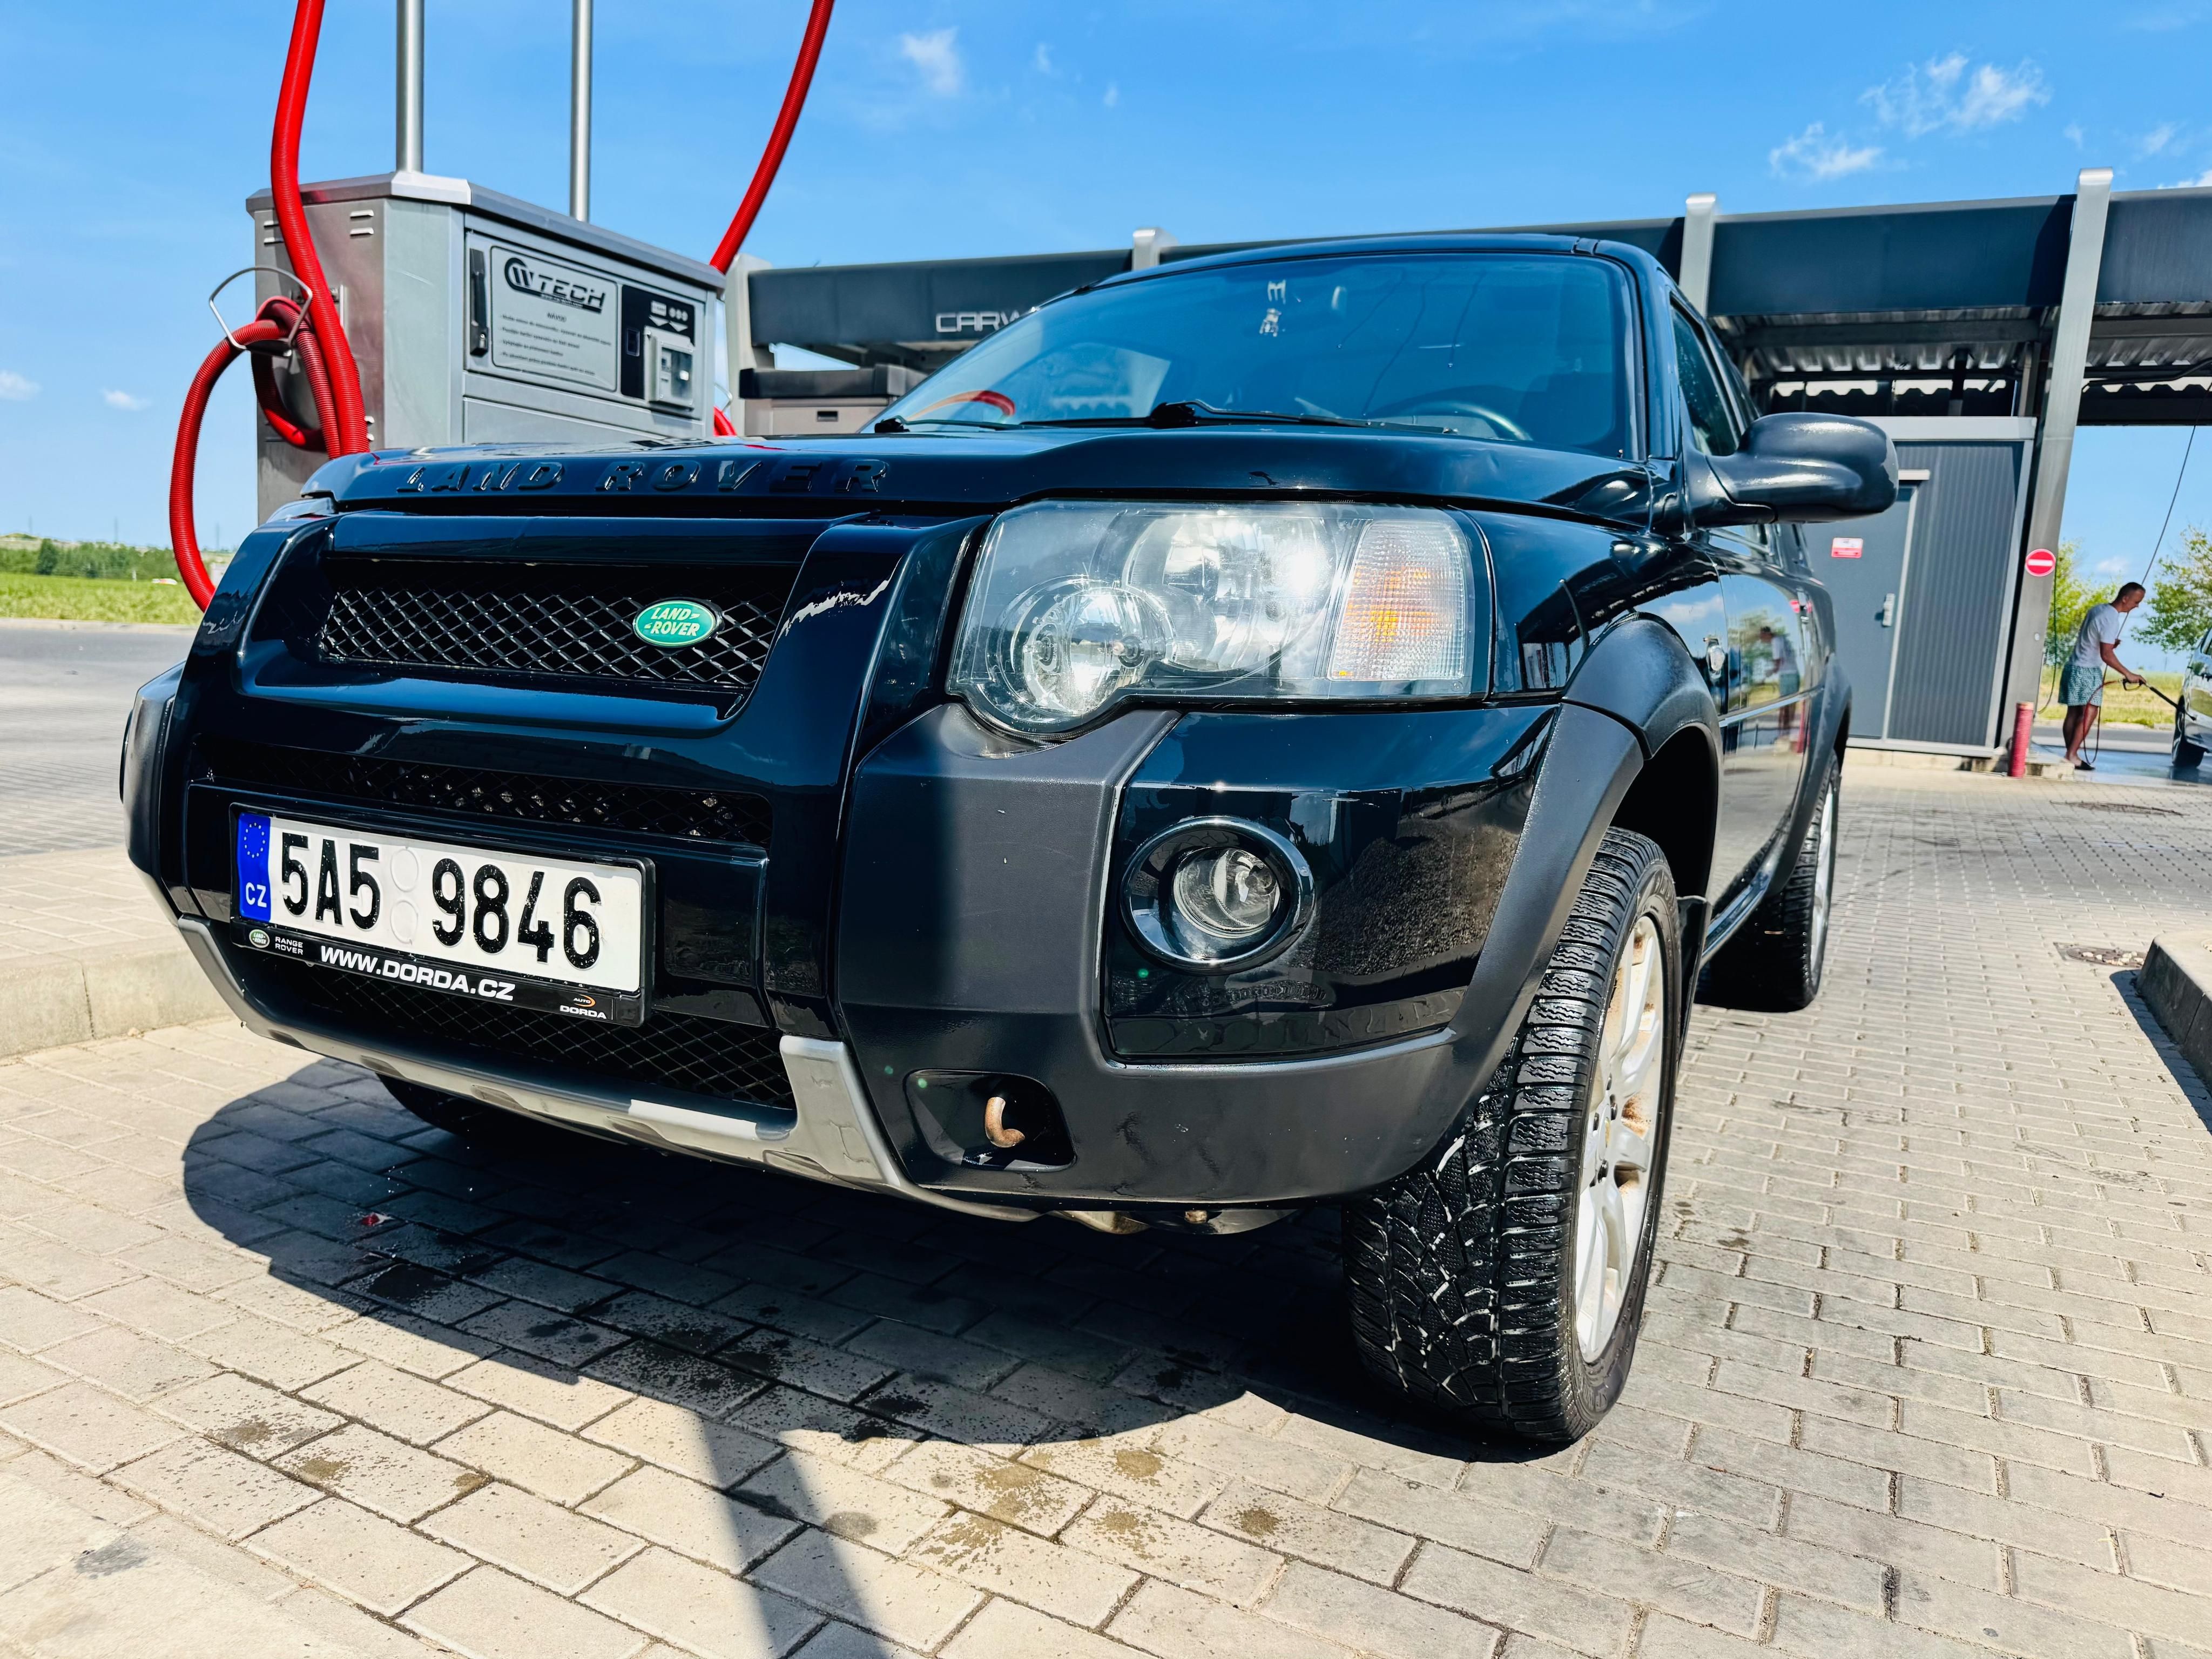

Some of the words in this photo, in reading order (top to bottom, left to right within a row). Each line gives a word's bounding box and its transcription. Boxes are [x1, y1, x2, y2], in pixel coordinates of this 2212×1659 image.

[538, 274, 605, 308] TECH
[396, 461, 565, 493] LAND
[594, 460, 889, 493] ROVER
[650, 621, 700, 636] ROVER
[245, 882, 267, 908] CZ
[282, 832, 381, 931] 5A5
[433, 858, 601, 969] 9846
[275, 936, 303, 948] RANGE
[275, 943, 304, 955] ROVER
[321, 946, 516, 1001] WWW.DORDA.CZ
[559, 1005, 607, 1020] DORDA
